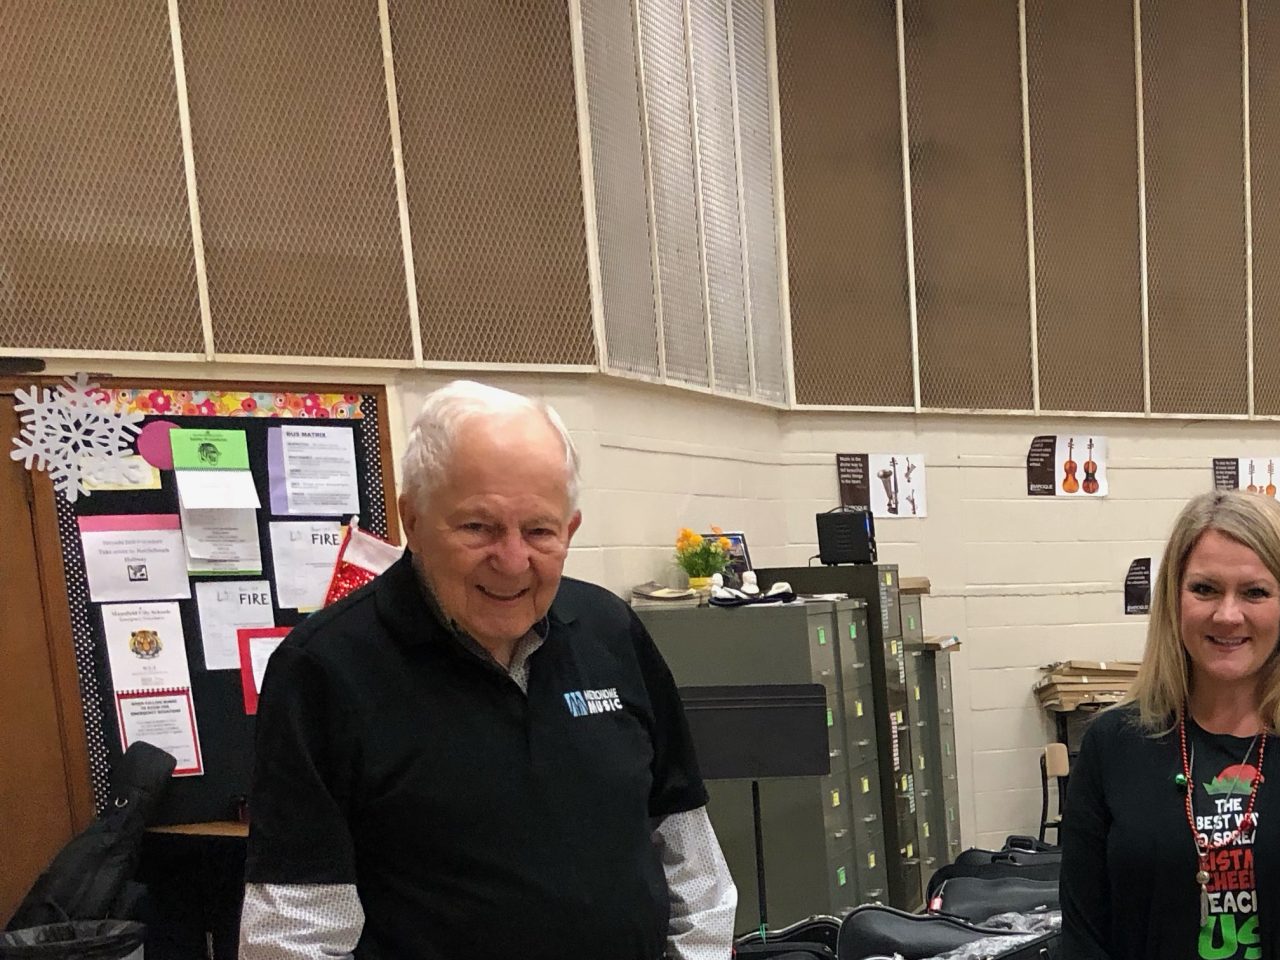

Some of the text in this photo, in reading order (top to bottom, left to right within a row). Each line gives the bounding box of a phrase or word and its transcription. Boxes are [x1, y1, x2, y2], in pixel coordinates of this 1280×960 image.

[311, 532, 341, 546] FIRE
[239, 592, 271, 606] FIRE
[587, 698, 623, 714] MUSIC
[1214, 797, 1243, 814] THE
[1195, 813, 1232, 831] BEST
[1206, 868, 1256, 892] CHEE
